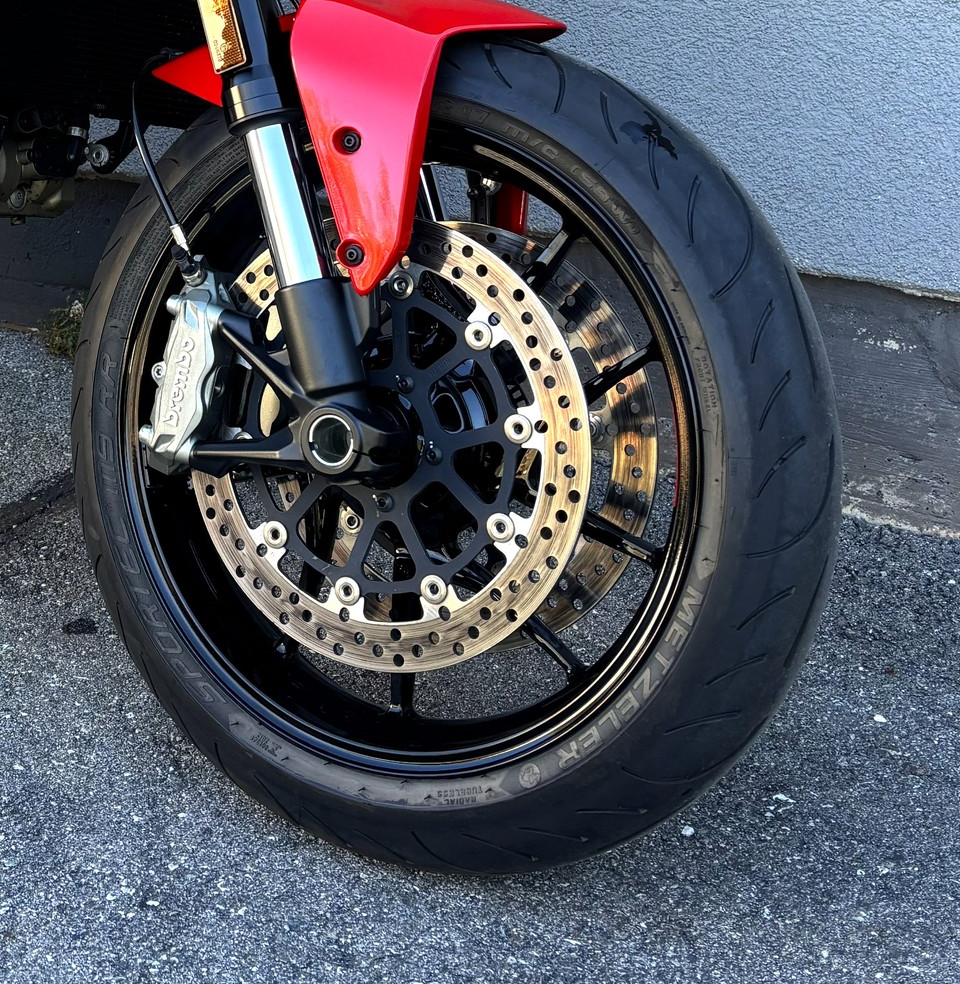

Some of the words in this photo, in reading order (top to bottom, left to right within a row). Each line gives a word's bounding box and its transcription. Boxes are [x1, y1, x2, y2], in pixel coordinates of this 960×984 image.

[97, 352, 119, 415] RR
[162, 336, 195, 427] brembo
[699, 354, 719, 408] ROTATION
[107, 514, 229, 707] SPORTEC
[557, 586, 705, 770] METZELER
[443, 796, 477, 806] RADIAL
